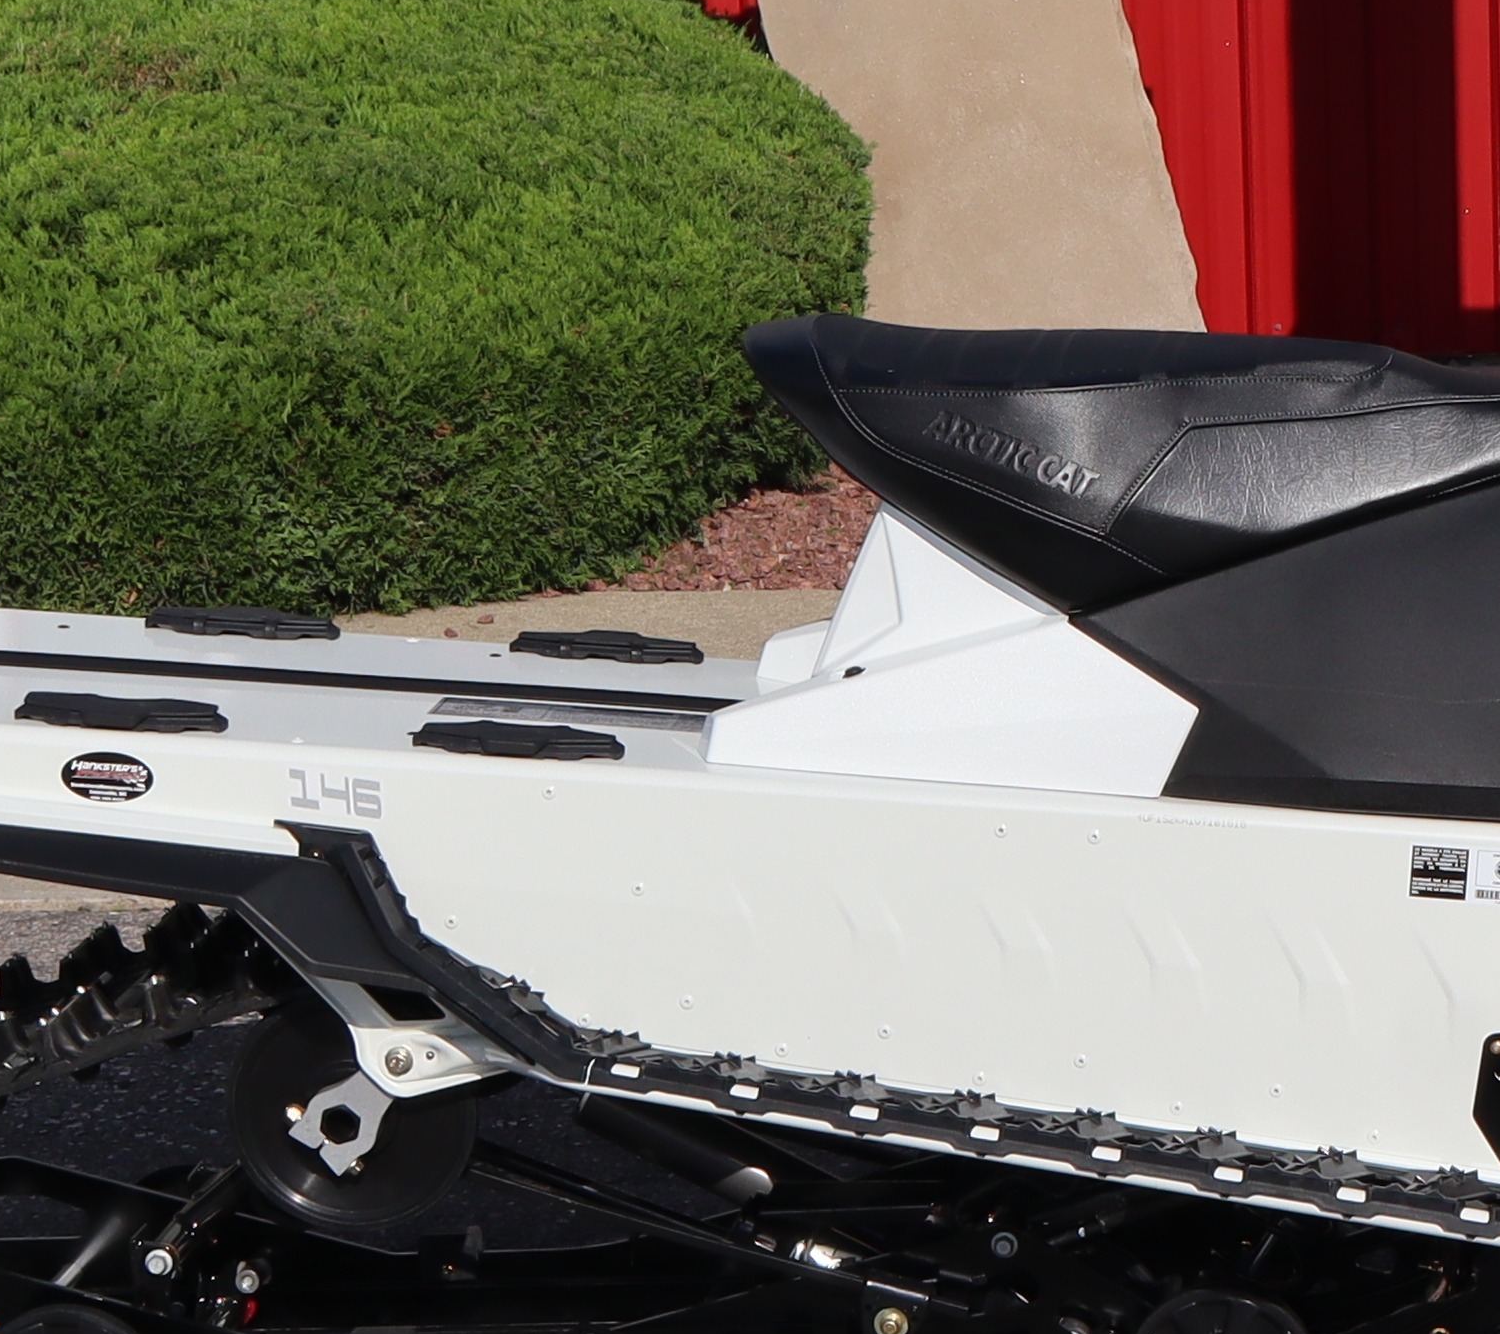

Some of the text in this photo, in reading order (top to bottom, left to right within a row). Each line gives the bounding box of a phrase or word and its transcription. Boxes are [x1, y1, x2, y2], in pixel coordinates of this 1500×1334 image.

[922, 410, 1100, 499] ARCTIC CAT
[288, 768, 382, 819] 146
